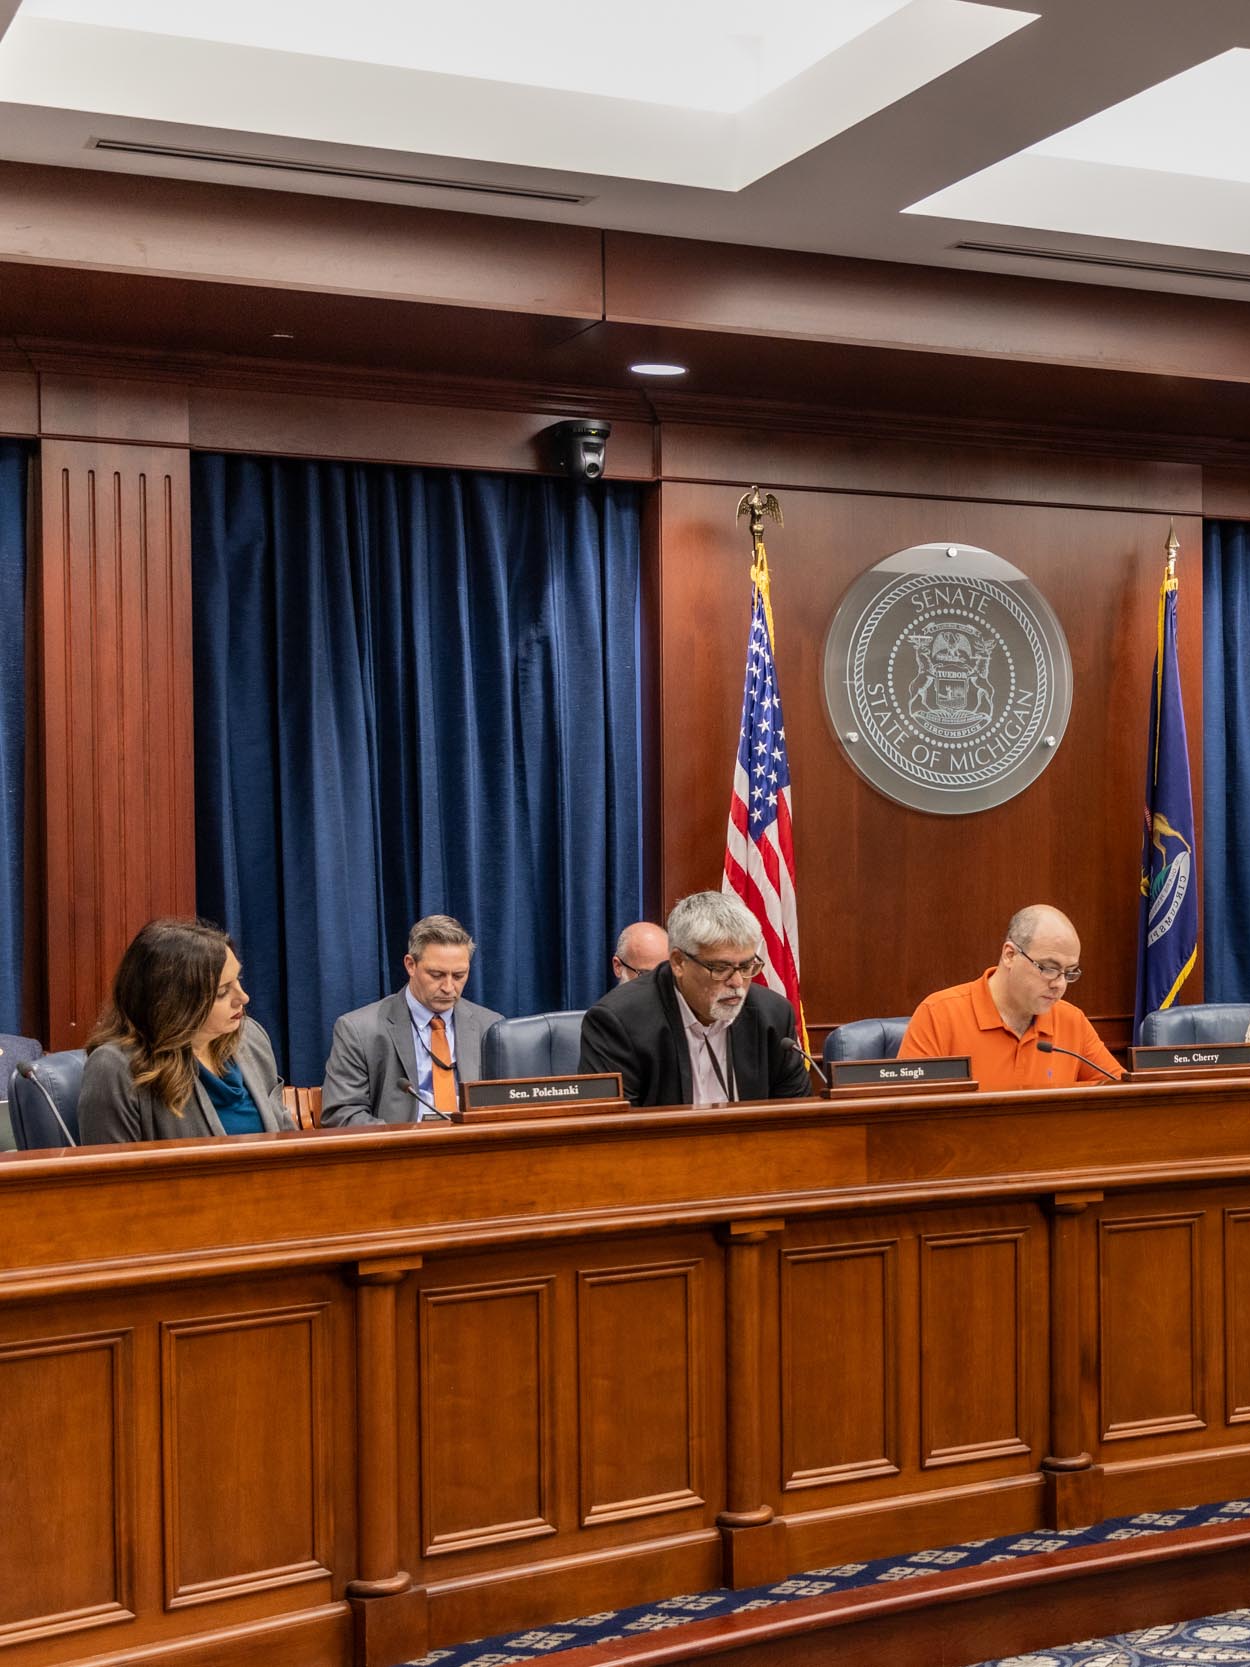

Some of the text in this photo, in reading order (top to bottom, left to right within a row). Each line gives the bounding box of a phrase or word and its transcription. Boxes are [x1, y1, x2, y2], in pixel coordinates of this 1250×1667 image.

[911, 587, 990, 614] SENATE
[867, 683, 1034, 771] STATE OF MICHIGAN
[923, 722, 982, 737] CIRCUMSPICE
[1173, 1053, 1219, 1064] Sen. Cherry
[879, 1067, 924, 1079] Sen. Singh
[509, 1084, 579, 1099] Sen. Polehanki
